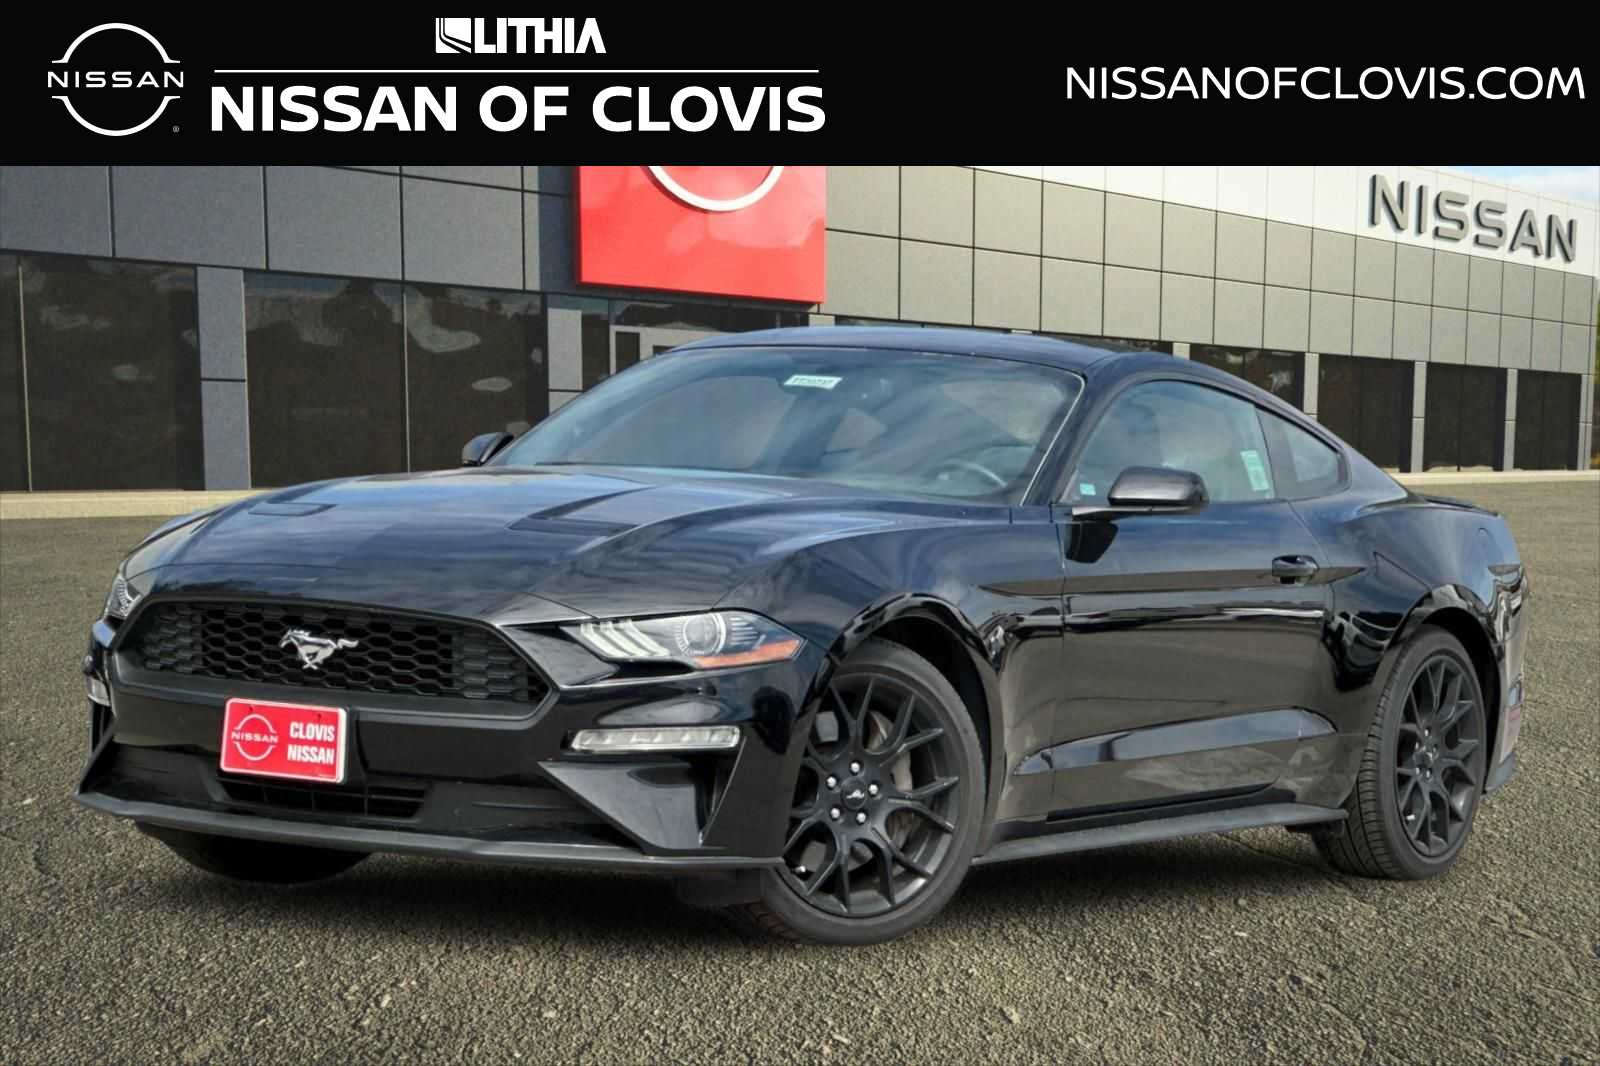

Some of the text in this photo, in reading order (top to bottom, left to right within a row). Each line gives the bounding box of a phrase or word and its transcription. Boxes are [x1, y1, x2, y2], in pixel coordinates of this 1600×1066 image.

[1368, 173, 1577, 263] NISSAN
[231, 731, 279, 743] NISSAN
[289, 721, 335, 742] CLOVIS
[287, 743, 335, 765] NISSAN
